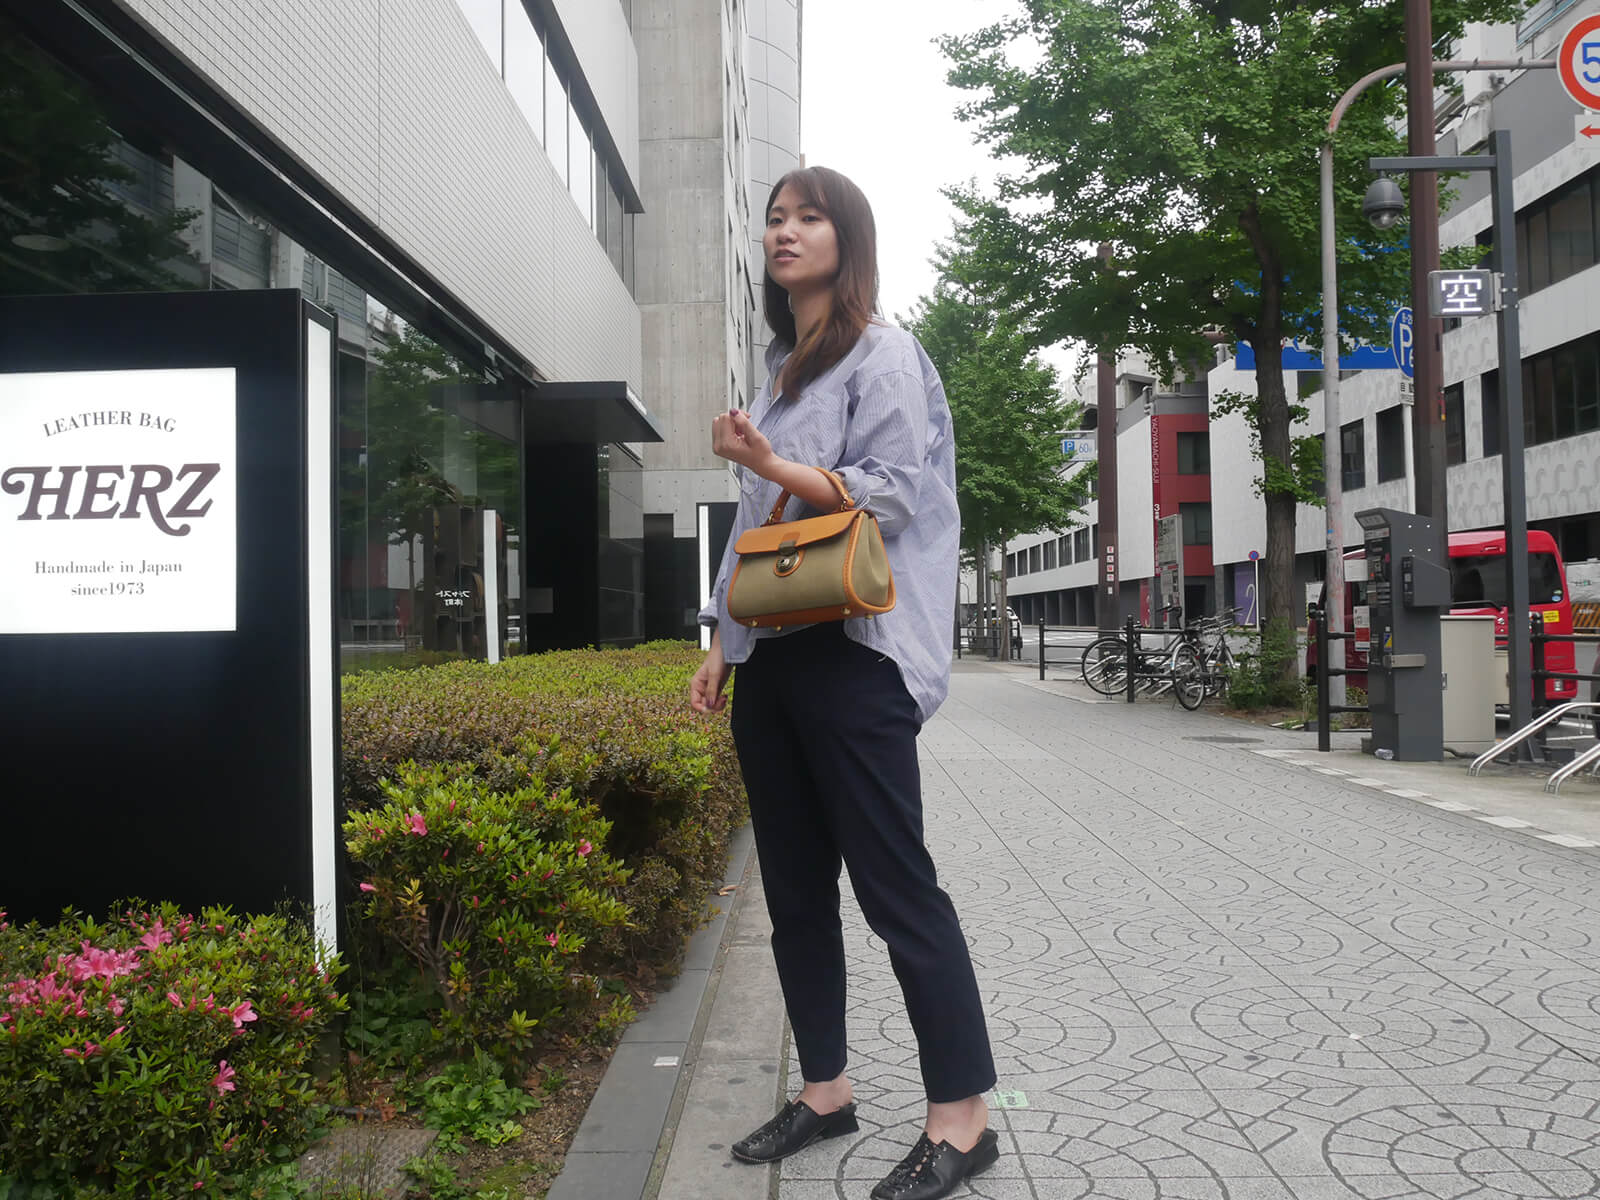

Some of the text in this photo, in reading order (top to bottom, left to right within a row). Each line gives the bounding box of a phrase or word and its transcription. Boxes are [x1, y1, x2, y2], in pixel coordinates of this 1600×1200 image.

[1440, 274, 1482, 312] 空
[43, 410, 176, 437] LEATHER BAG
[1, 463, 221, 537] HERZ
[35, 560, 182, 577] Handmade in Japan
[71, 582, 145, 596] since1973
